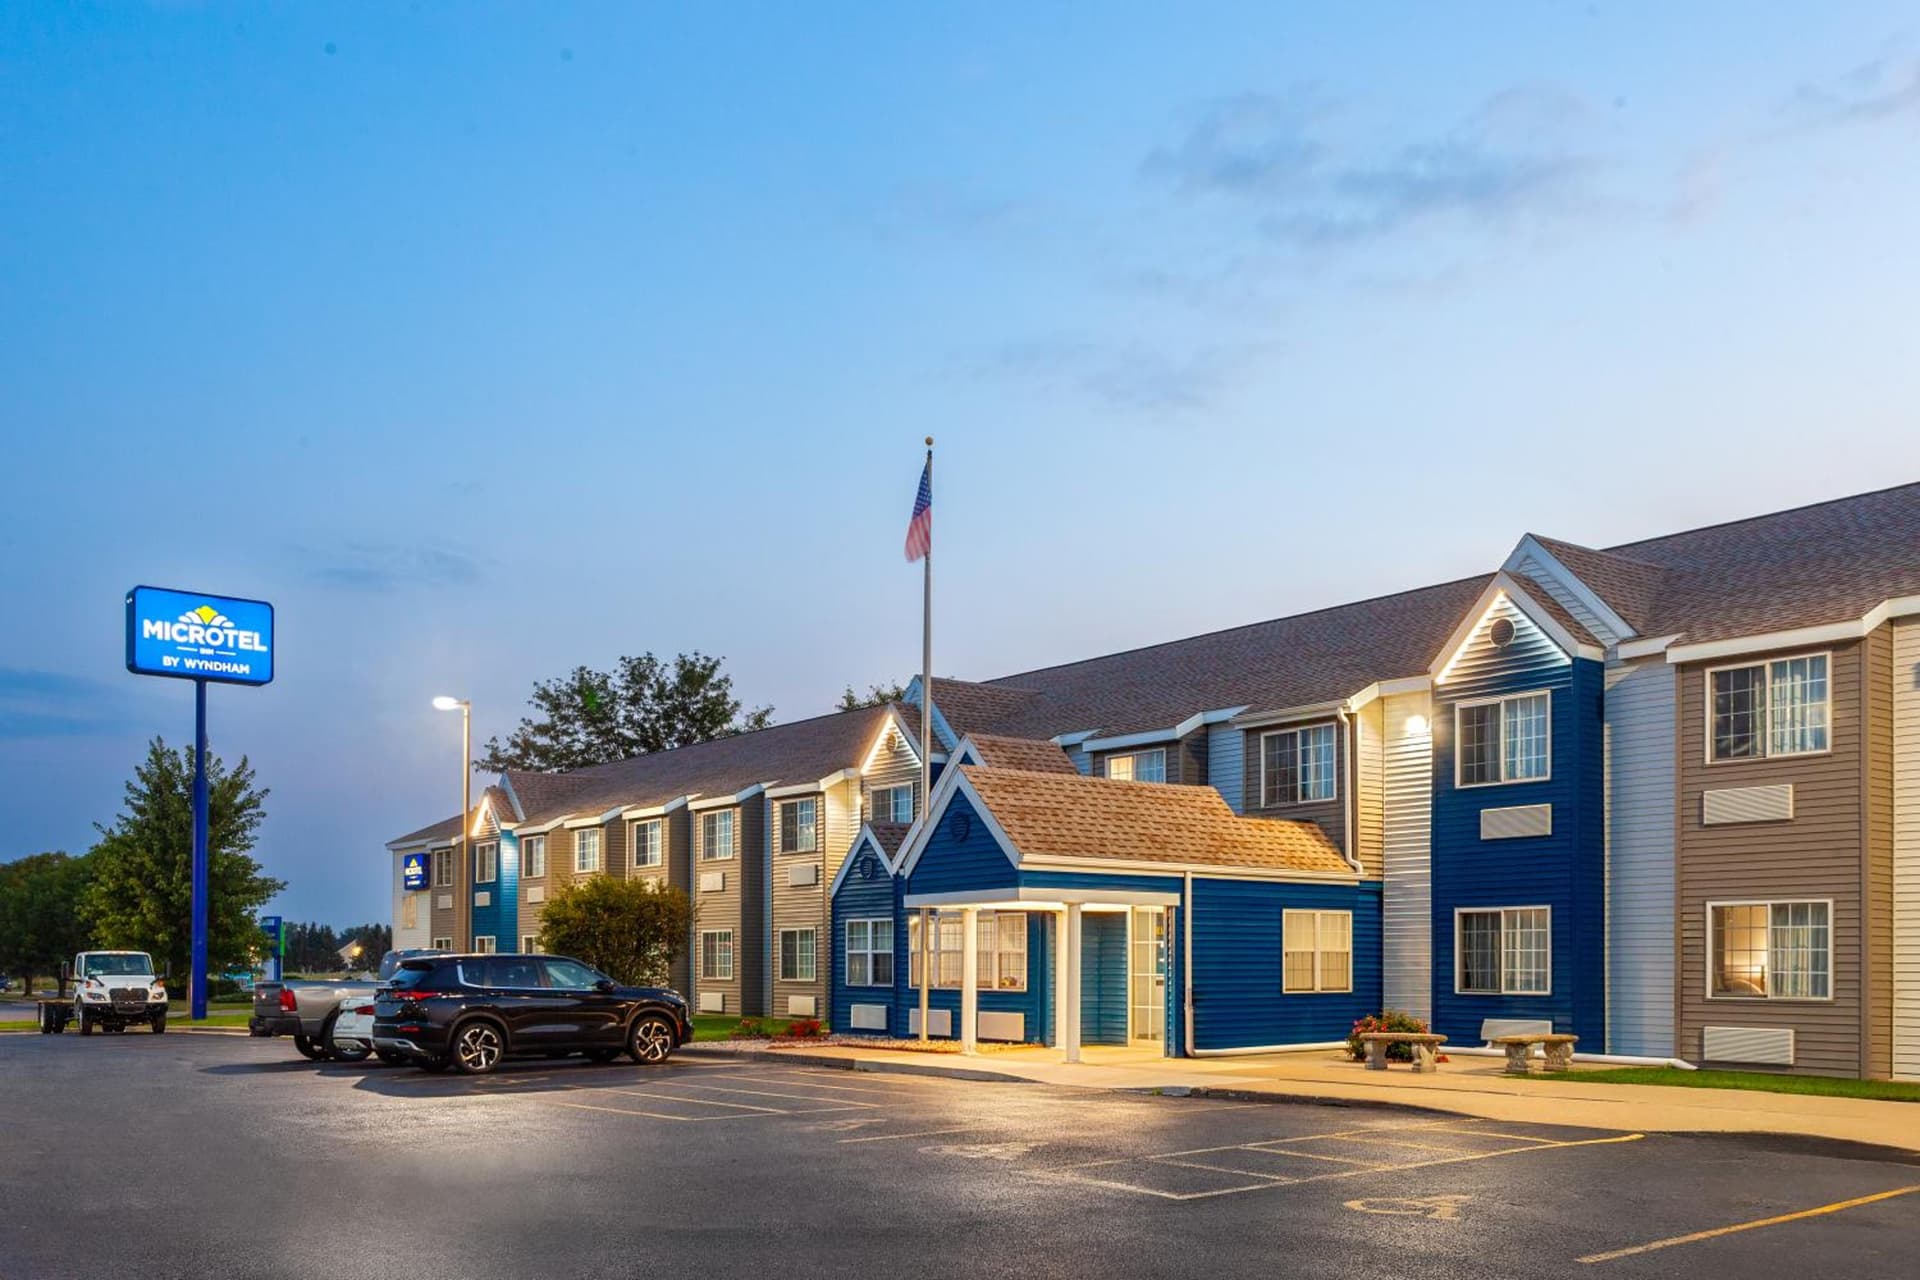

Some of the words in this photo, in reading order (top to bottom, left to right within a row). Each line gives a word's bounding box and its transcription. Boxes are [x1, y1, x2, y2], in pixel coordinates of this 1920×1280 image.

[143, 619, 267, 652] MICROTEL
[163, 656, 179, 667] BY
[184, 659, 250, 674] WYNDHAM
